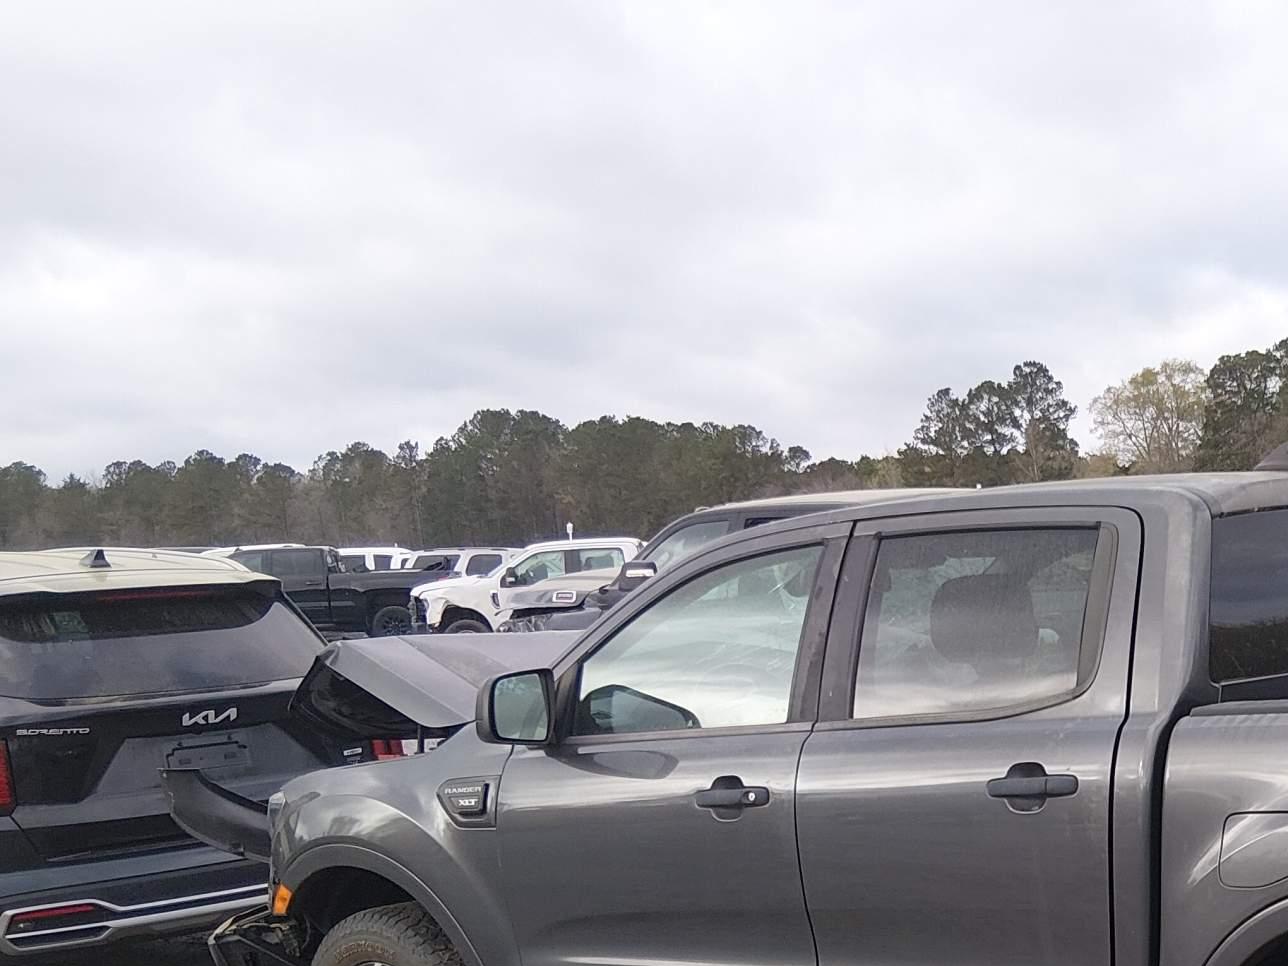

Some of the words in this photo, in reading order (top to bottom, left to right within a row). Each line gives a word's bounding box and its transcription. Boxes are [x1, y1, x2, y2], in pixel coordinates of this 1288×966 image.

[181, 707, 238, 727] KIA
[16, 727, 90, 736] SORENTO
[444, 786, 482, 795] RANGER
[458, 798, 479, 807] XLT
